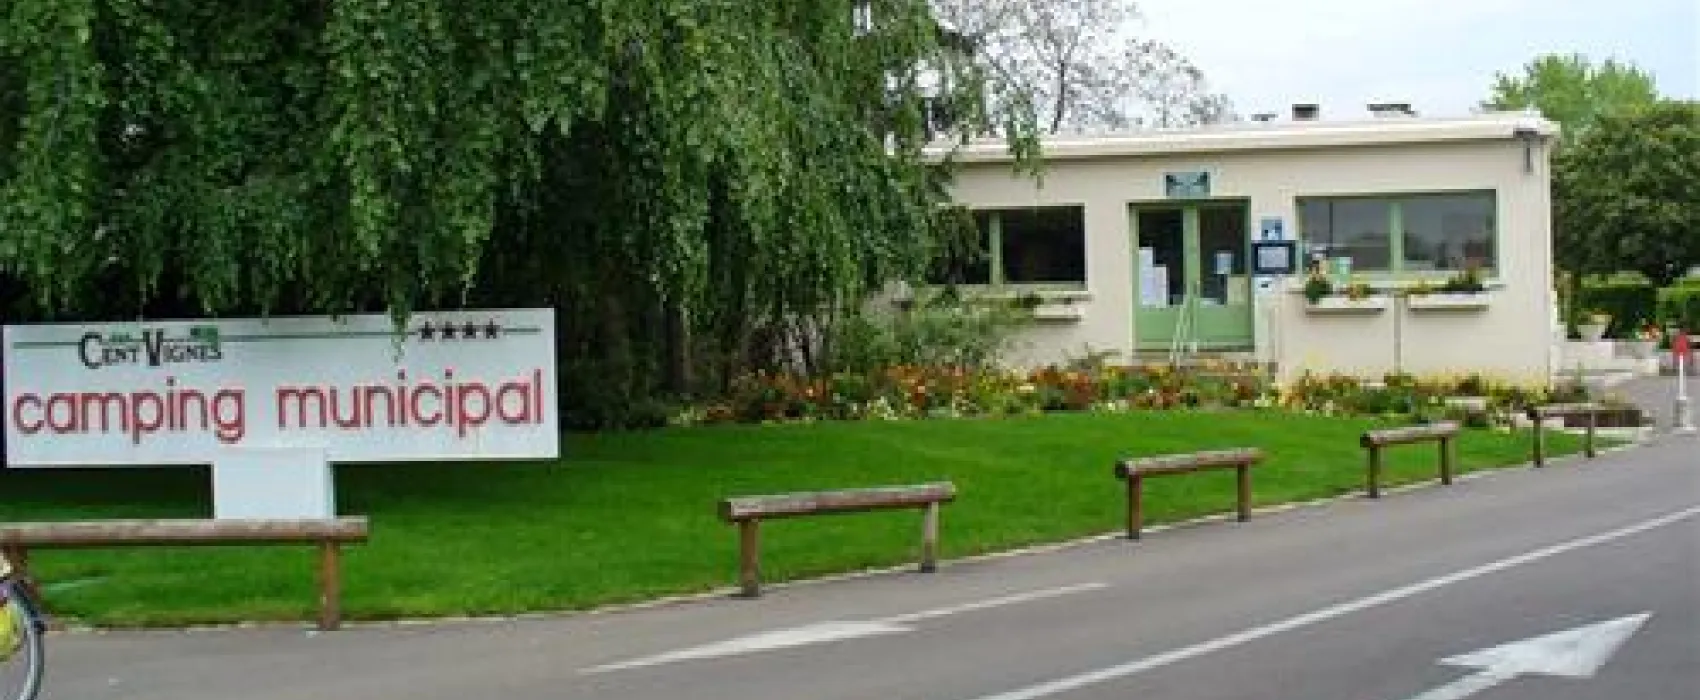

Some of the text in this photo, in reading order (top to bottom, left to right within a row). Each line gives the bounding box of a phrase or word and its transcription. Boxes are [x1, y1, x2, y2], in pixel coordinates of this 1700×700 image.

[79, 331, 138, 369] CENT
[13, 369, 544, 444] camping municipal
